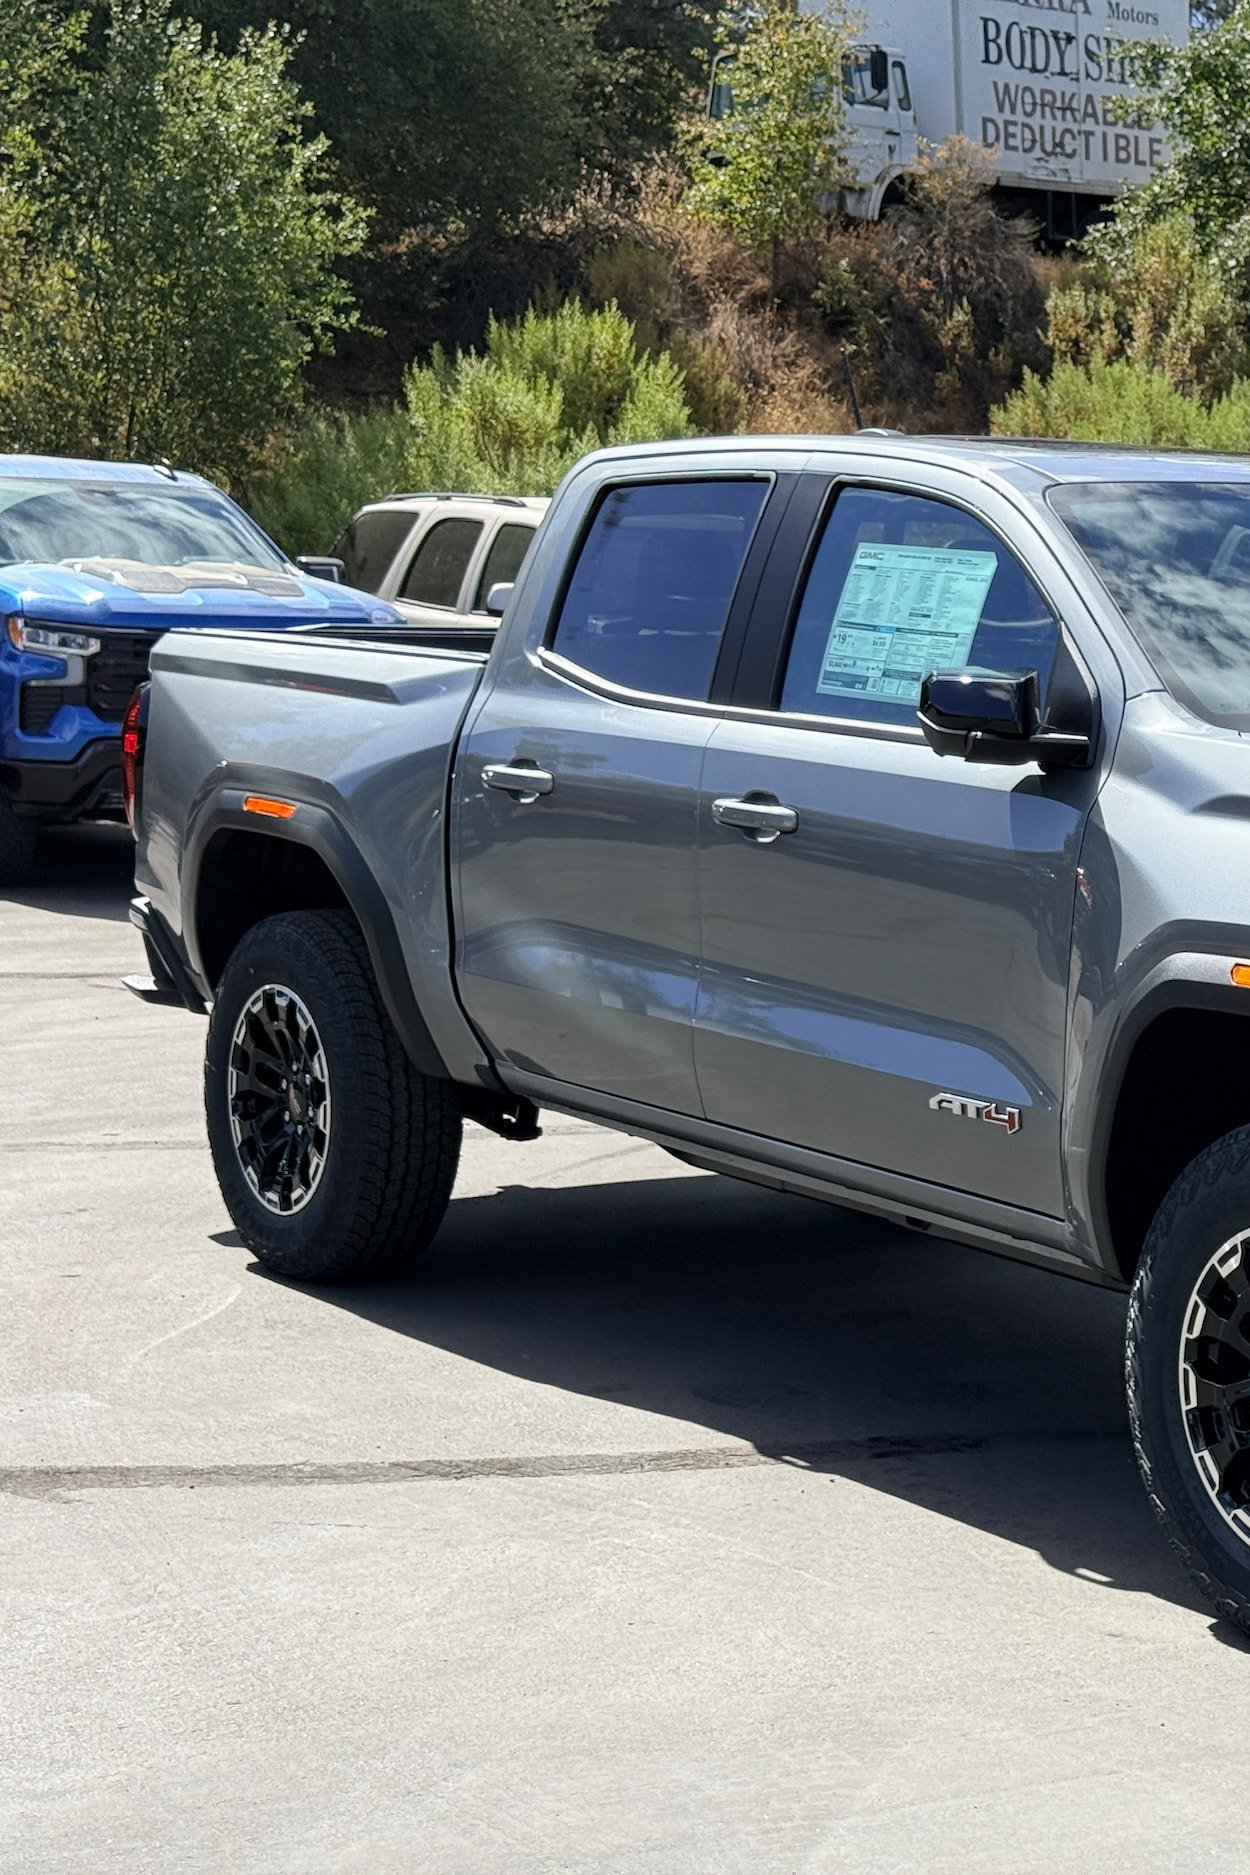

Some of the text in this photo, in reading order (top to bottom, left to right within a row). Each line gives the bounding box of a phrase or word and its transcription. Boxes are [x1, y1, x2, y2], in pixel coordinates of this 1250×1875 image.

[1107, 1, 1160, 26] Motors
[979, 16, 1077, 77] BODY
[981, 116, 1163, 167] DEDUCTIBLE
[929, 1092, 1020, 1134] AT4
